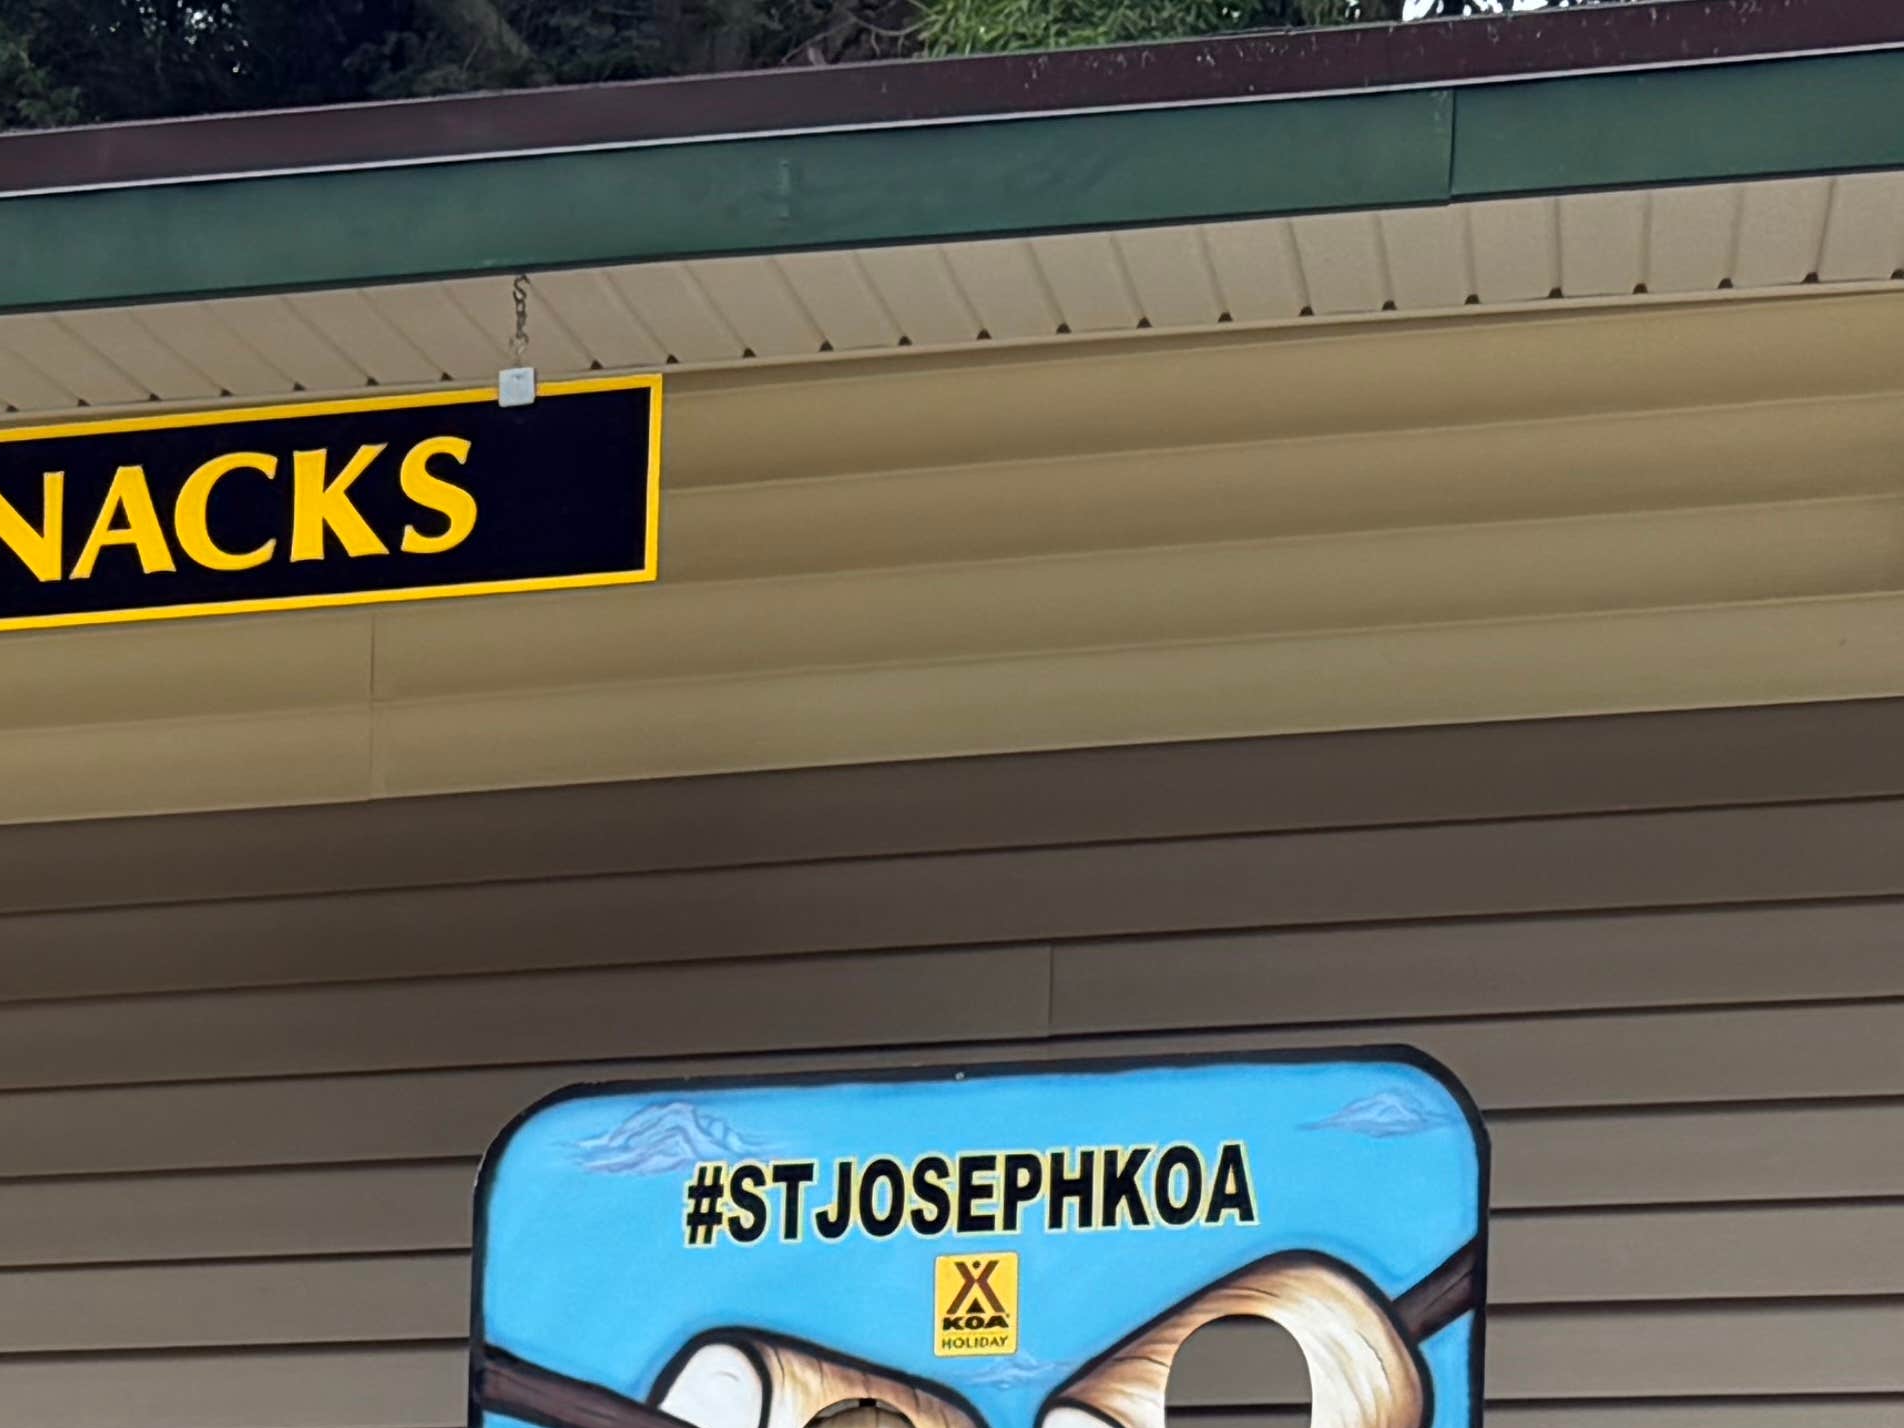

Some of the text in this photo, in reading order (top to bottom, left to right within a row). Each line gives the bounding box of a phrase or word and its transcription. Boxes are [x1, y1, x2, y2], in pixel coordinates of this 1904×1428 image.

[686, 1142, 1256, 1246] #STJOSEPHKOA
[942, 1315, 1010, 1331] KOA
[941, 1335, 1009, 1350] HOLIDAY
